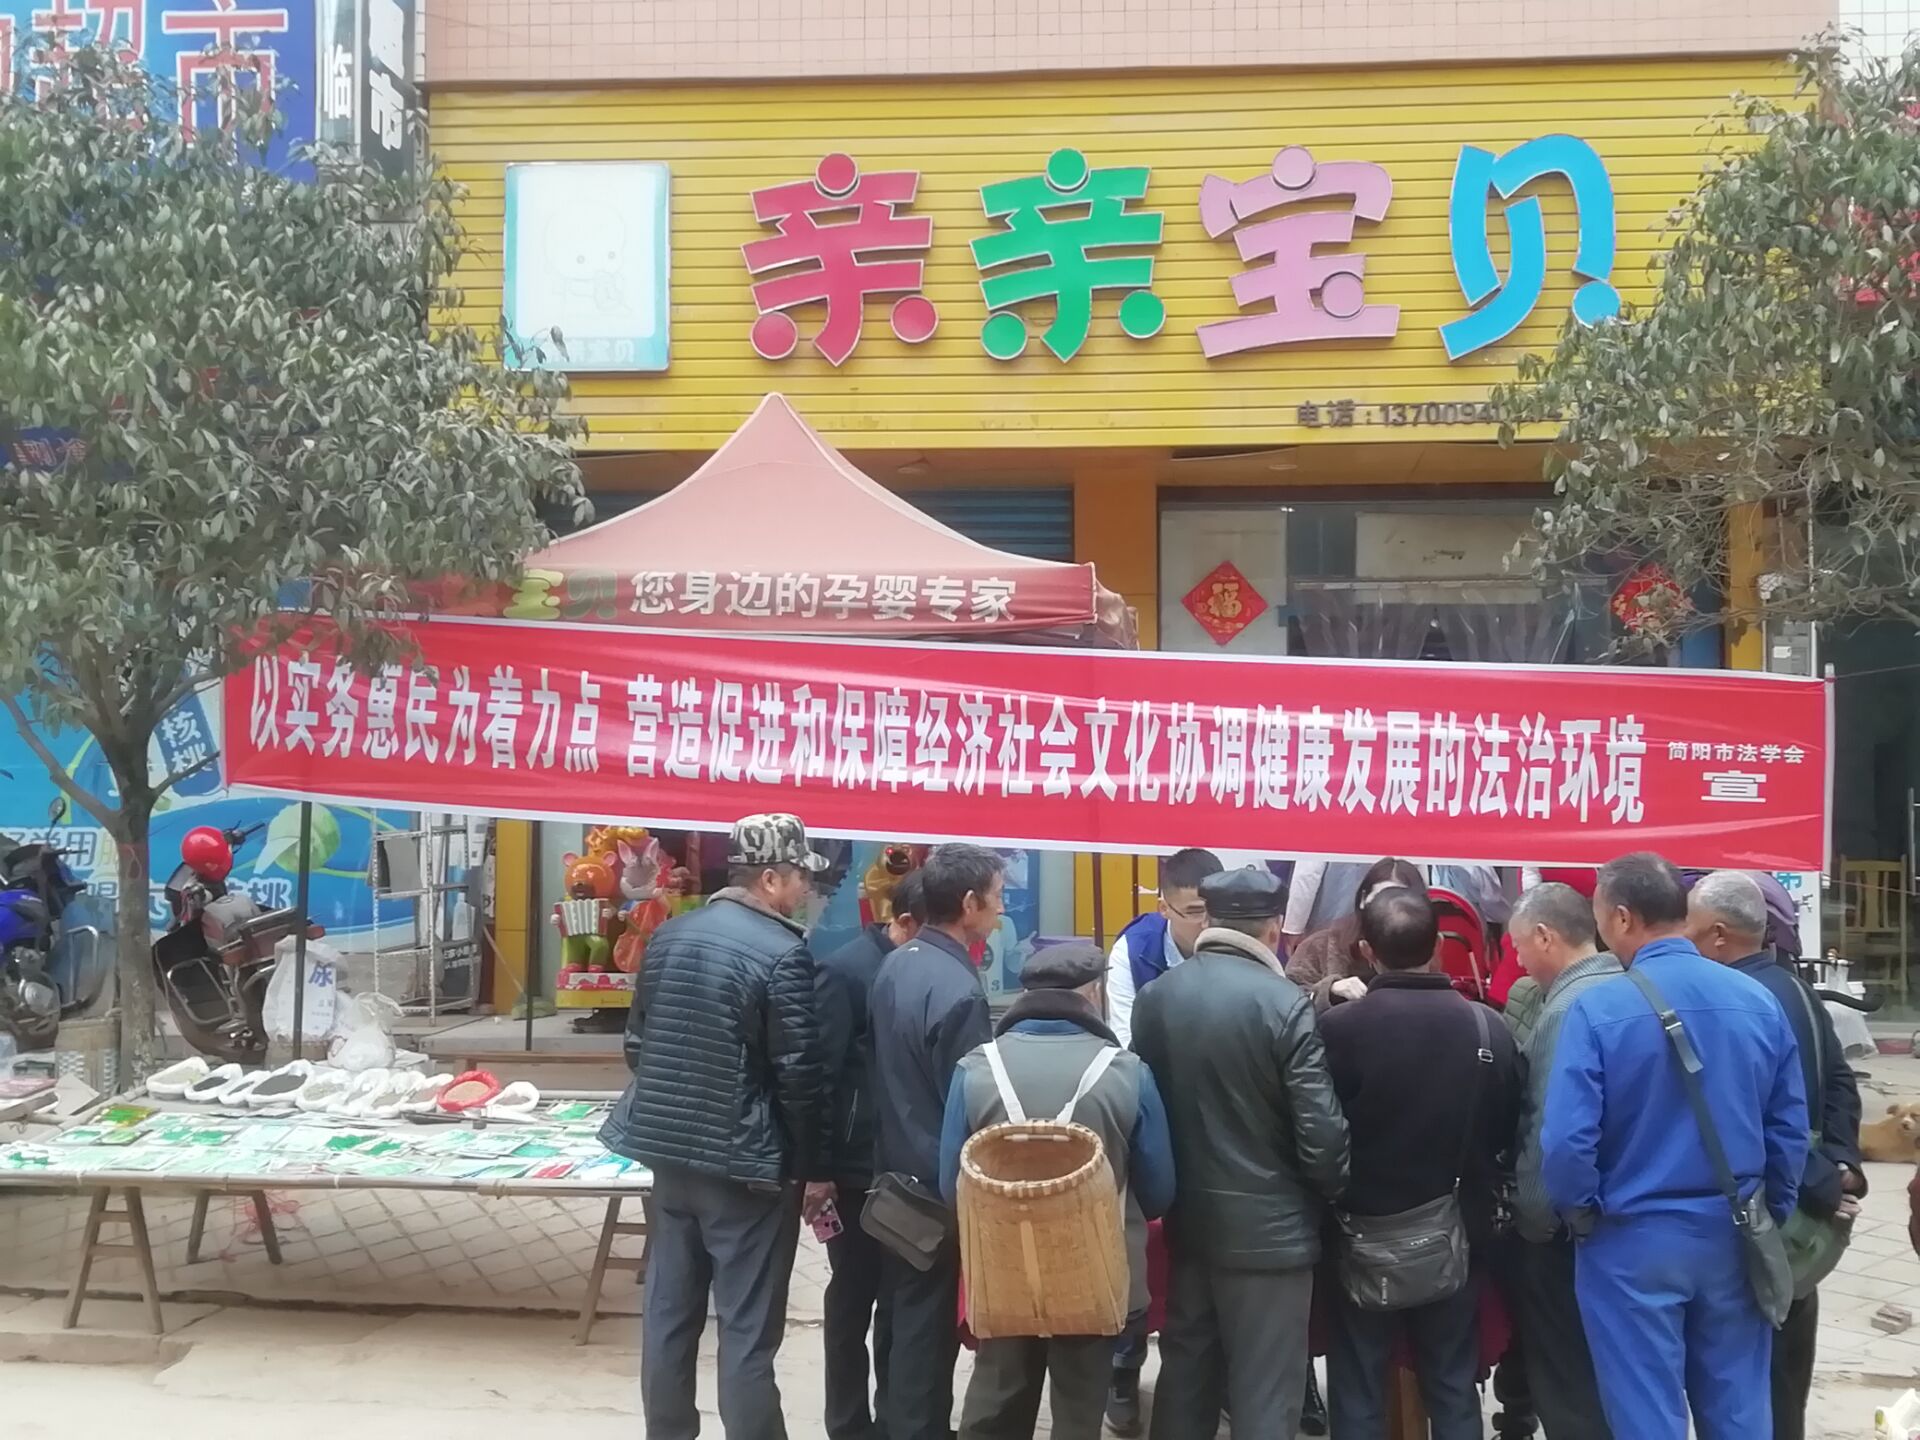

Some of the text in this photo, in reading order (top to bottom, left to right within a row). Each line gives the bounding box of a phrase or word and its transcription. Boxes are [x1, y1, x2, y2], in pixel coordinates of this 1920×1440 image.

[0, 0, 288, 165] 超市
[740, 133, 1622, 367] 亲亲宝贝
[629, 570, 1018, 623] 您身边的孕婴专家
[250, 652, 1647, 825] 以实务惠民为着力点 营造促进和保障经济社会文化协调健康发展的法治环境
[1667, 741, 1806, 764] 简阳市法学会
[1701, 770, 1767, 803] 宣
